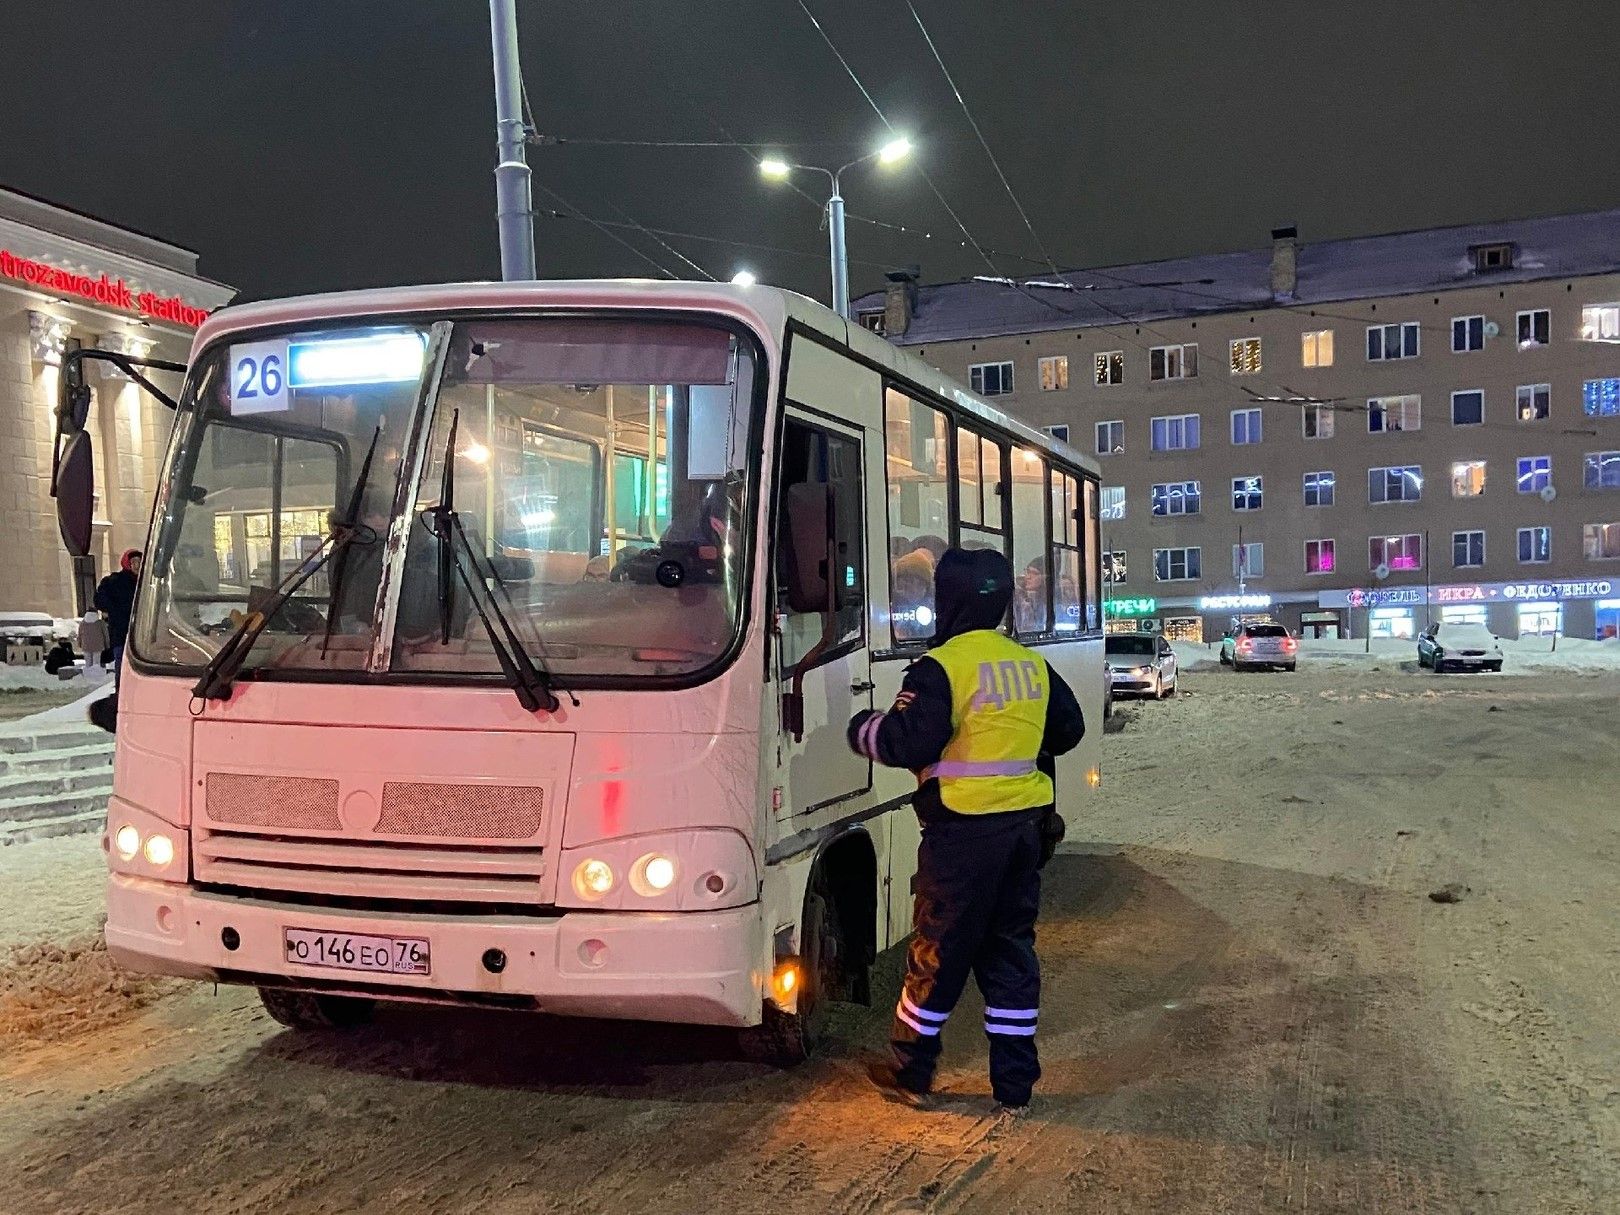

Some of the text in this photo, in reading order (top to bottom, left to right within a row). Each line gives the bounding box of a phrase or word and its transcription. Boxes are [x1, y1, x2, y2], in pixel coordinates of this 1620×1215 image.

[0, 250, 209, 327] trozavodsk station
[237, 354, 282, 399] 26
[1438, 587, 1485, 600] ИКРА
[970, 660, 1042, 711] ДПС
[395, 961, 414, 970] RUS
